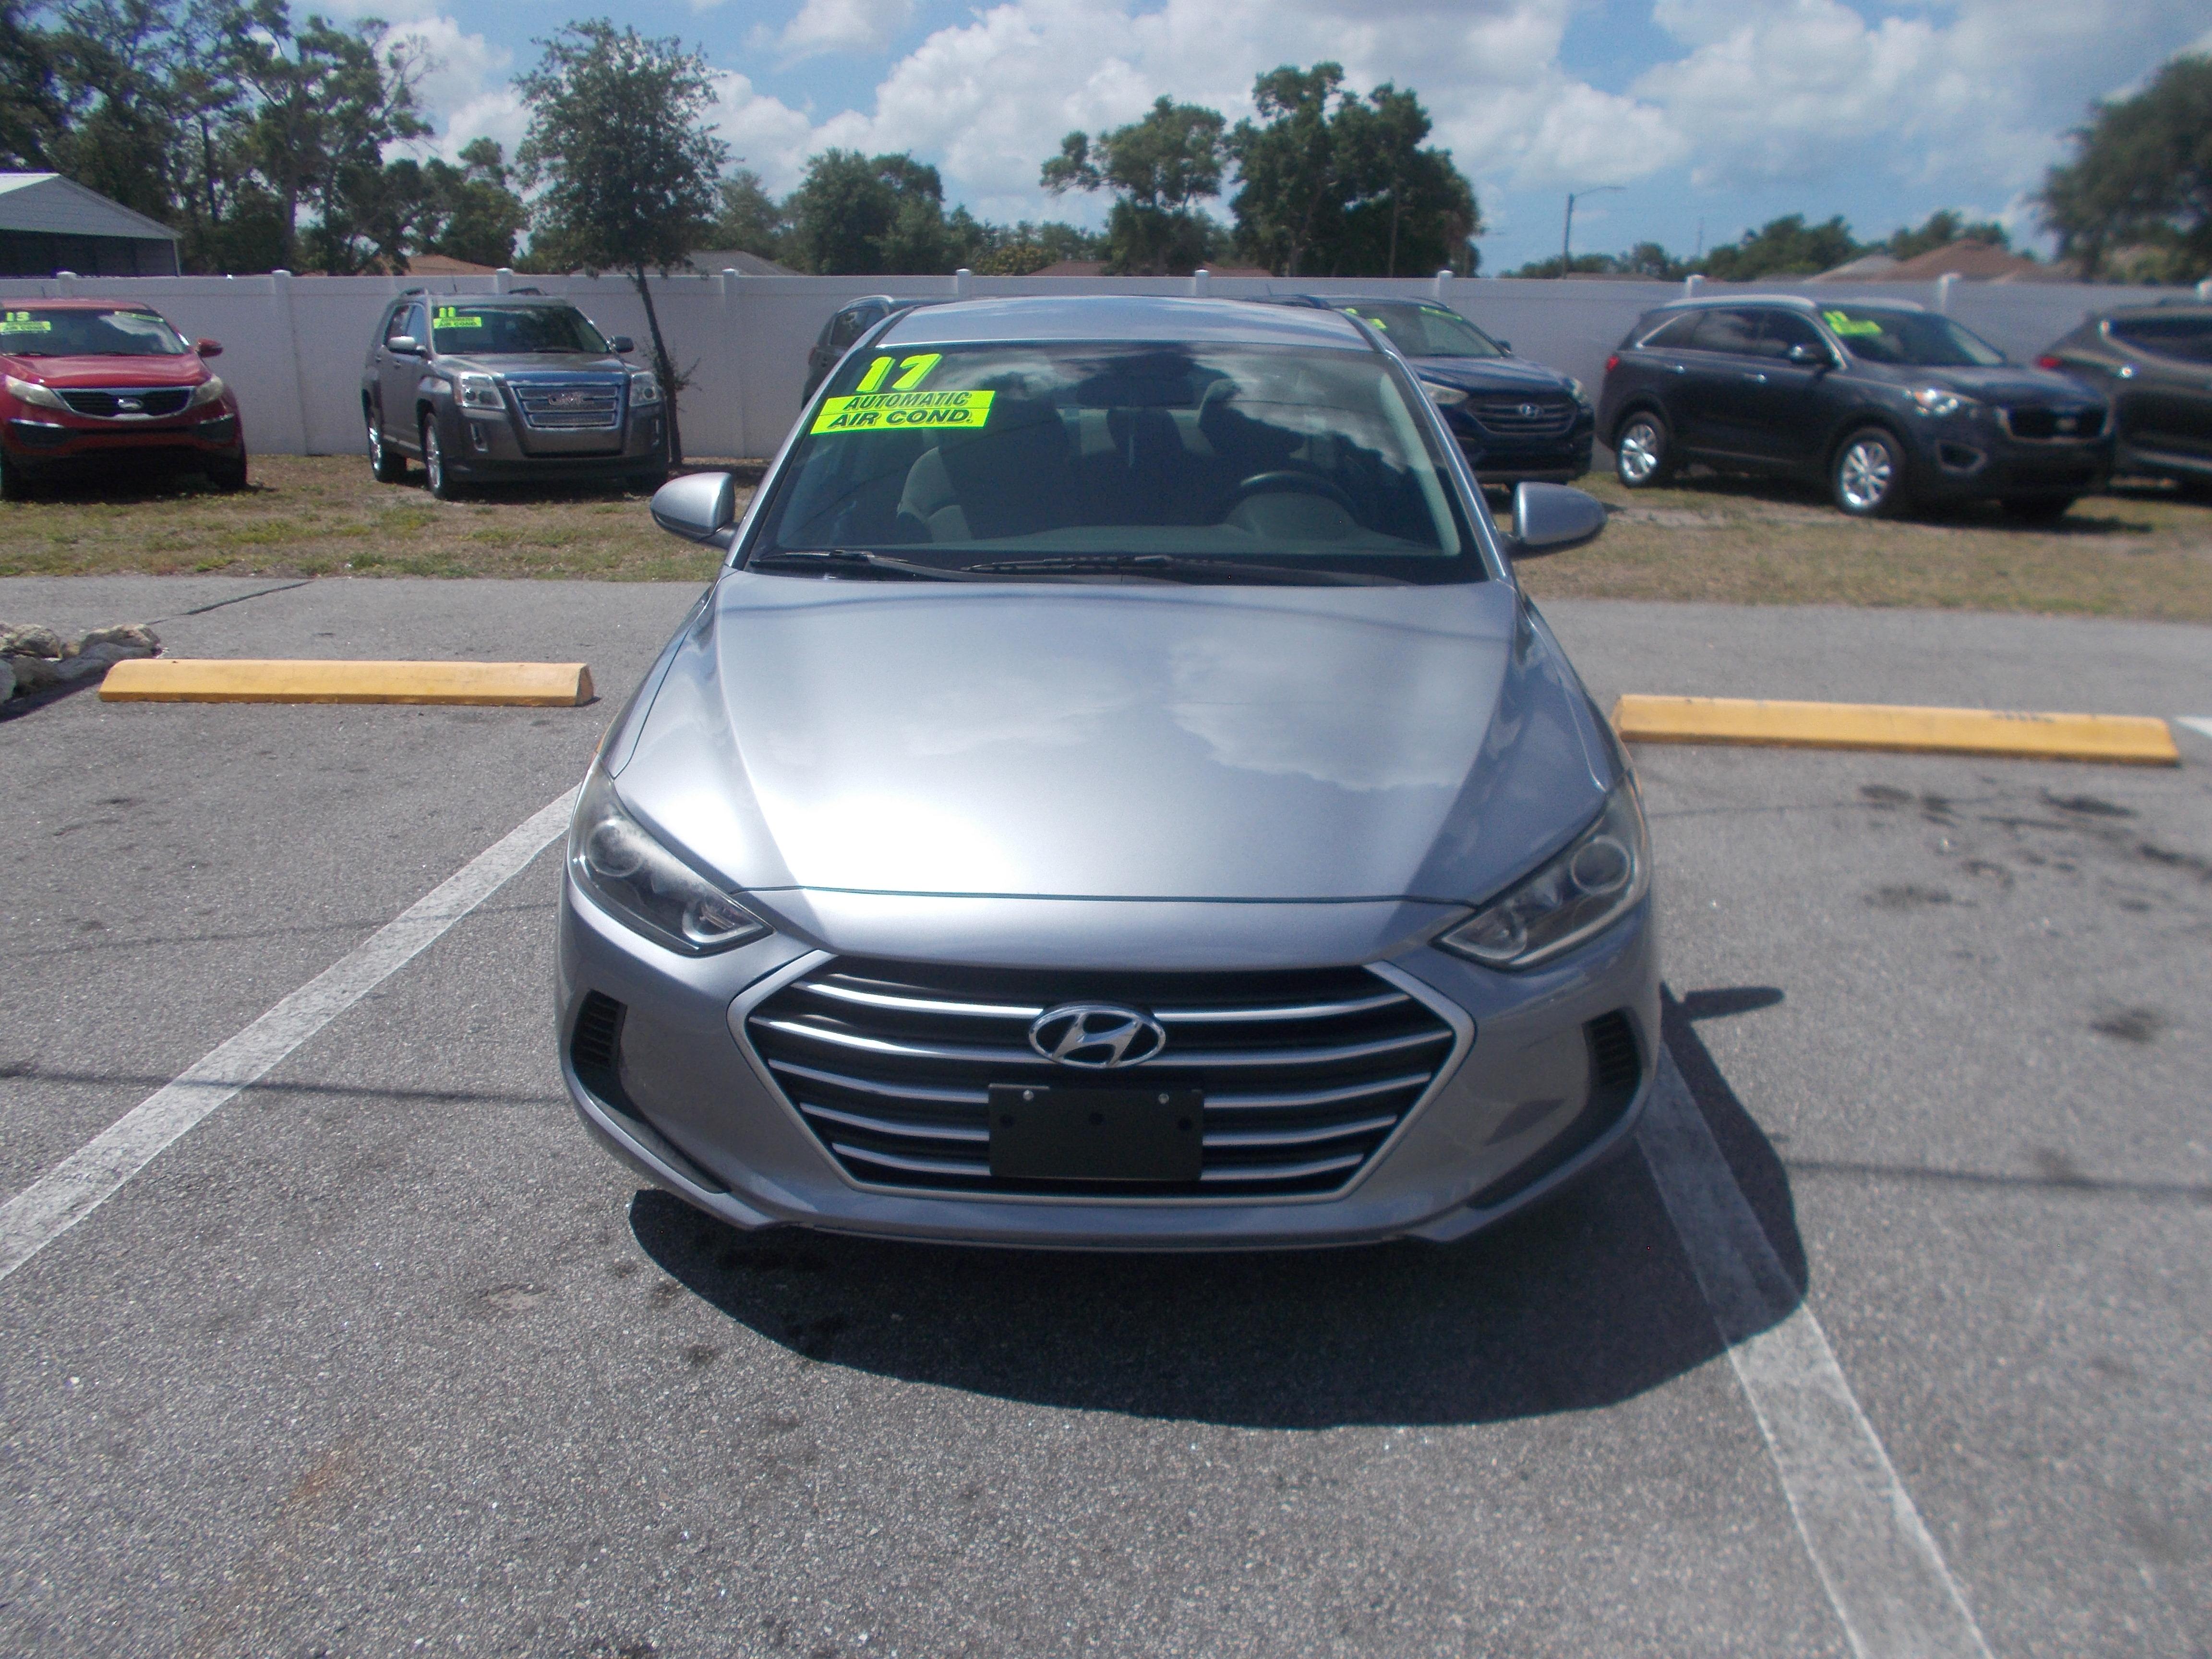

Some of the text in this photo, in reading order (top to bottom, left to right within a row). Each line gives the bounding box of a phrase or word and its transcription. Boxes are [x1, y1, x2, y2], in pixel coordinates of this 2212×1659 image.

[856, 354, 942, 393] 17
[547, 392, 594, 407] GMC
[842, 392, 972, 411] AUTOMATIC
[827, 409, 973, 429] AIR COND.
